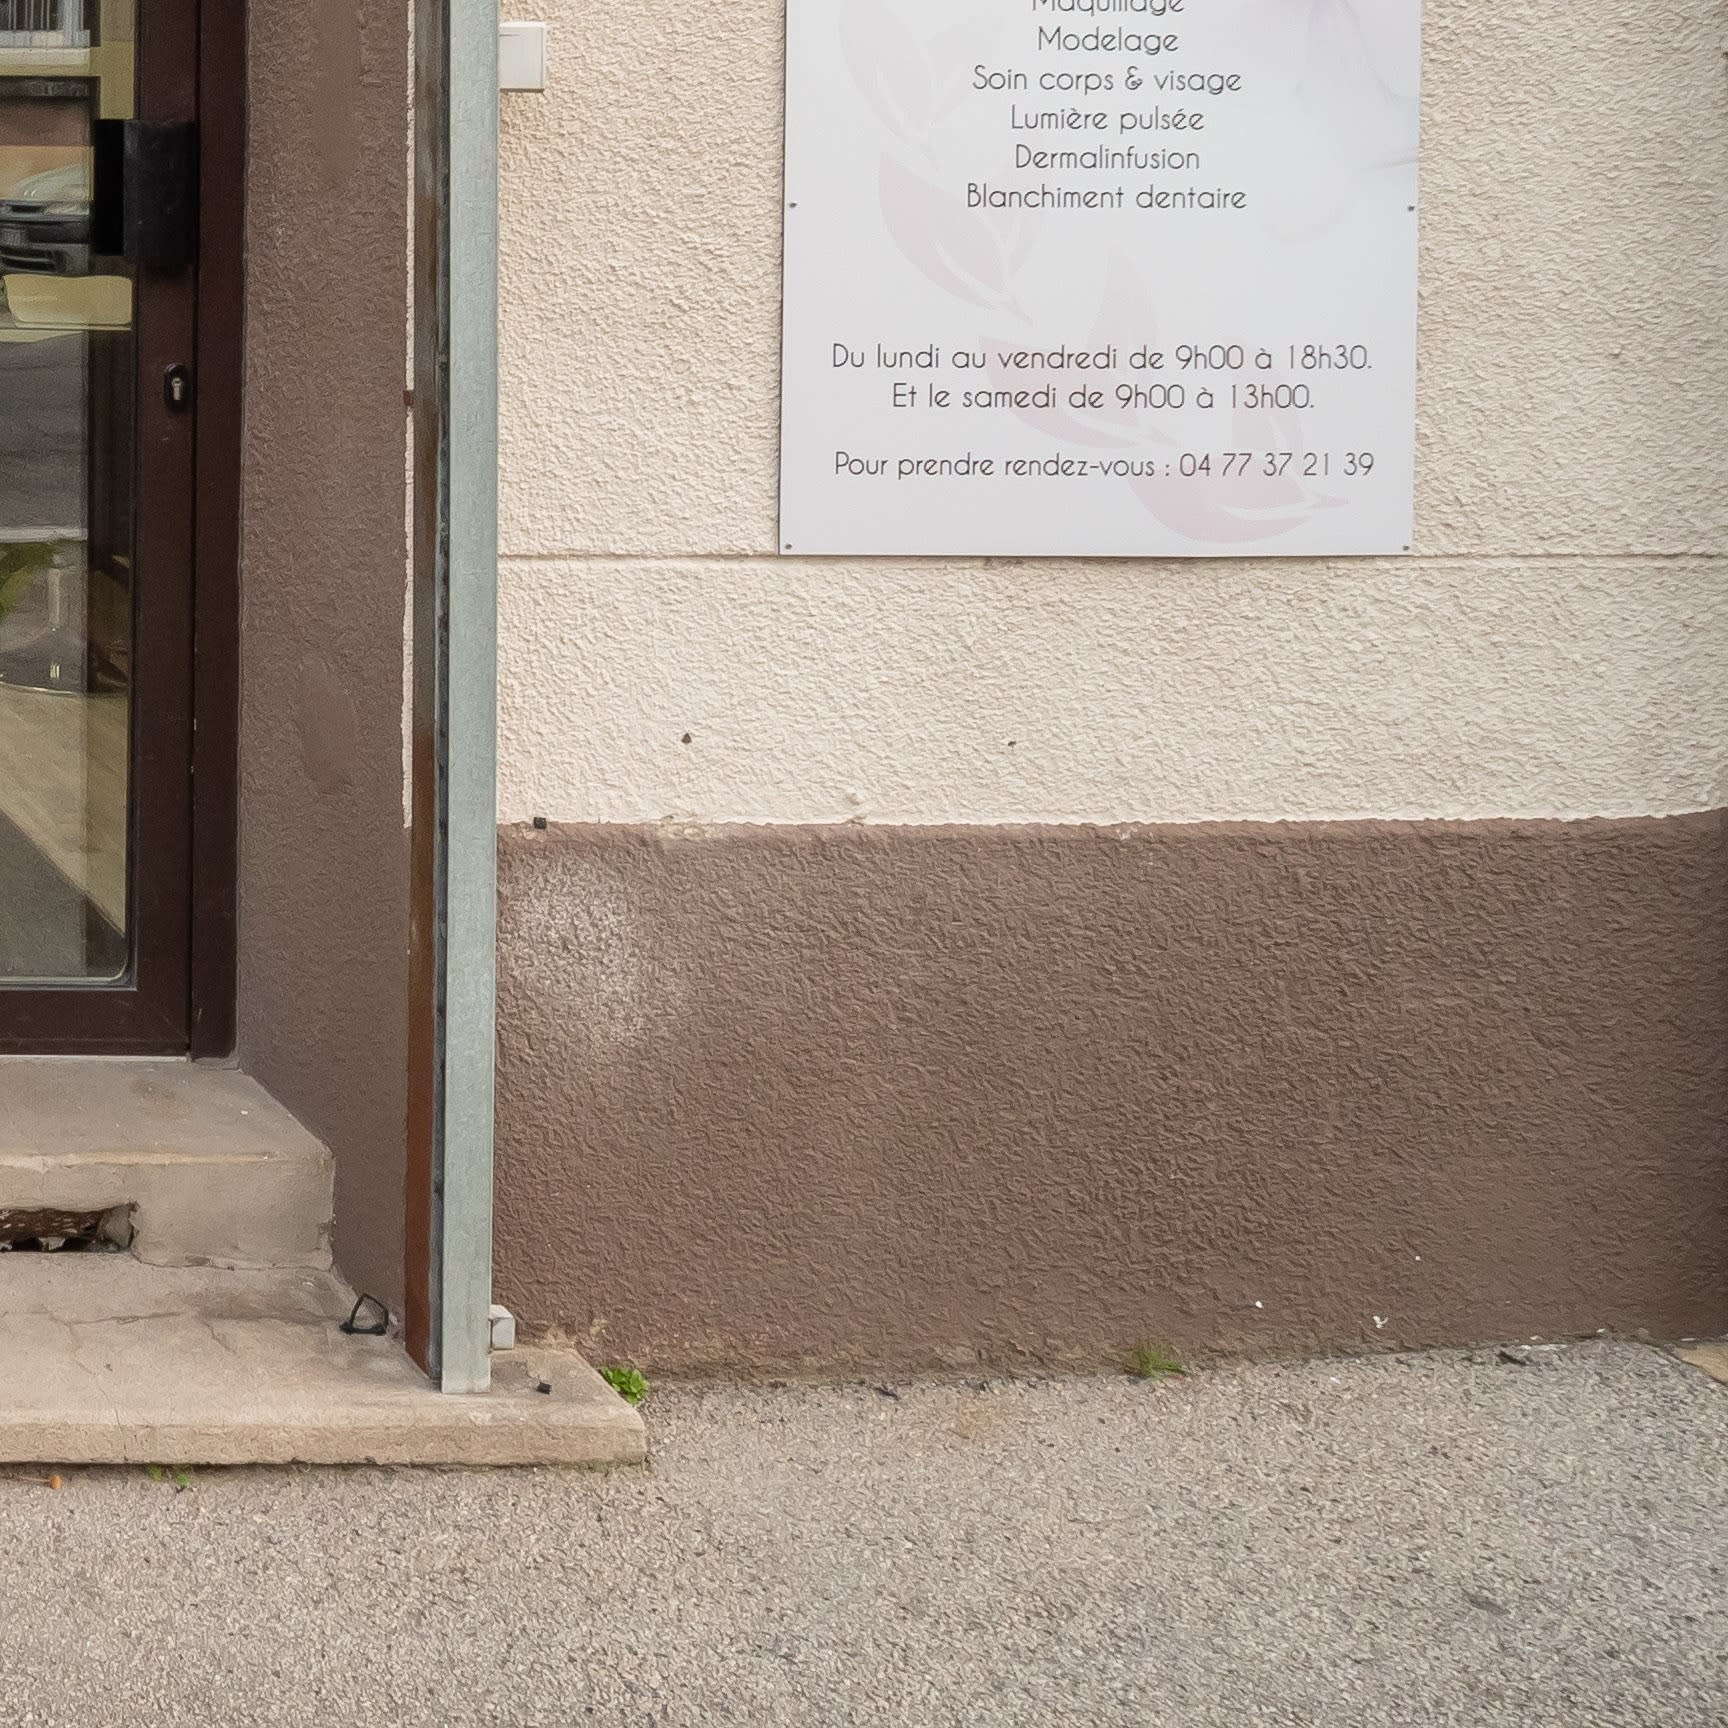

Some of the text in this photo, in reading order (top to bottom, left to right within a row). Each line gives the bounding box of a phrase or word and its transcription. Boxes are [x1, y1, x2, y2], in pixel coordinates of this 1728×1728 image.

[1039, 26, 1178, 55] Modelage
[973, 65, 1241, 95] Soin corps & visage
[1012, 105, 1204, 134] Lumière pulsée
[1016, 144, 1199, 169] Dermalinfusion
[968, 183, 1246, 208] Blanchiment dentaire
[833, 343, 1372, 369] Du lundi au vendredi de 9h00 à 18h30.
[893, 383, 1314, 408] Et le samedi de 9h00 à 13h00.
[836, 451, 1373, 480] Pour prendre rendez-vous : 04 77 37 21 39
